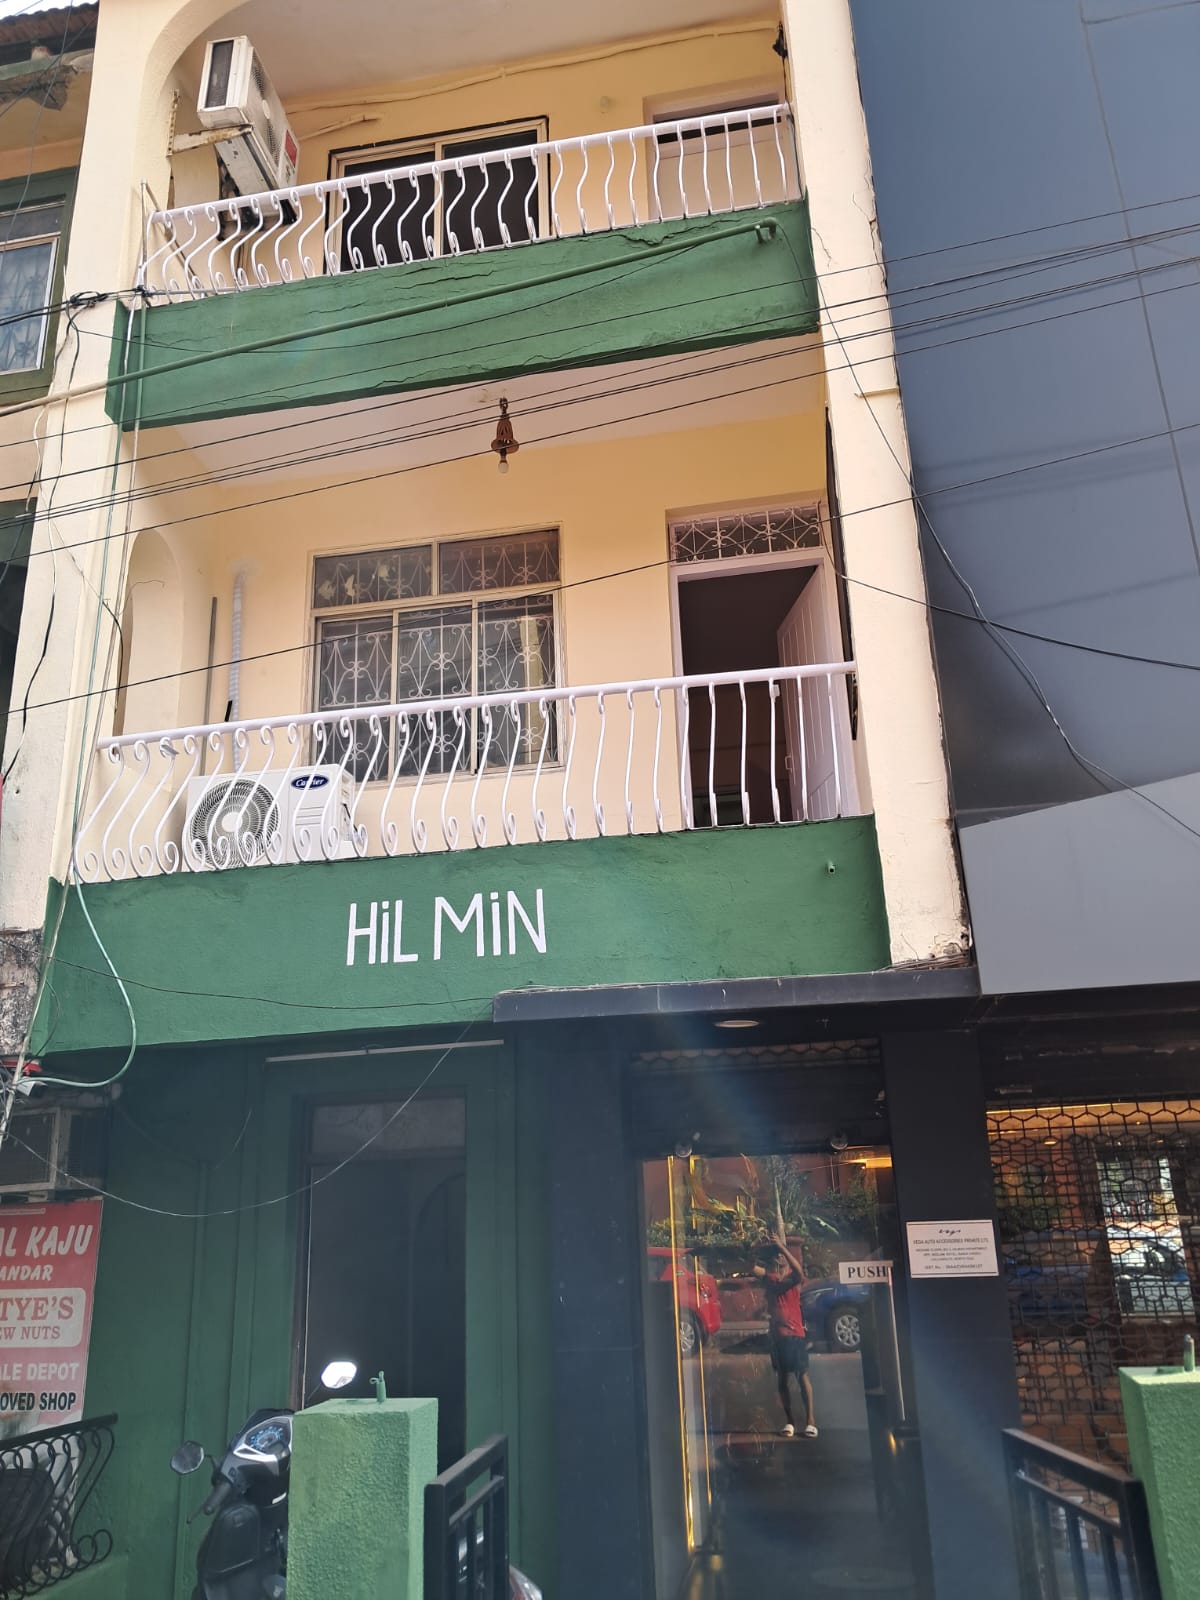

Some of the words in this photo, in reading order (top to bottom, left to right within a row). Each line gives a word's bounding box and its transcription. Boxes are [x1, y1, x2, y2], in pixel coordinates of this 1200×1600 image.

[24, 1224, 94, 1259] KAJU
[848, 1266, 886, 1278] PUSH
[0, 1326, 17, 1340] W
[20, 1325, 61, 1340] NUTS
[0, 1363, 23, 1381] LE
[26, 1362, 81, 1381] DEPOT
[39, 1391, 76, 1411] SHOP
